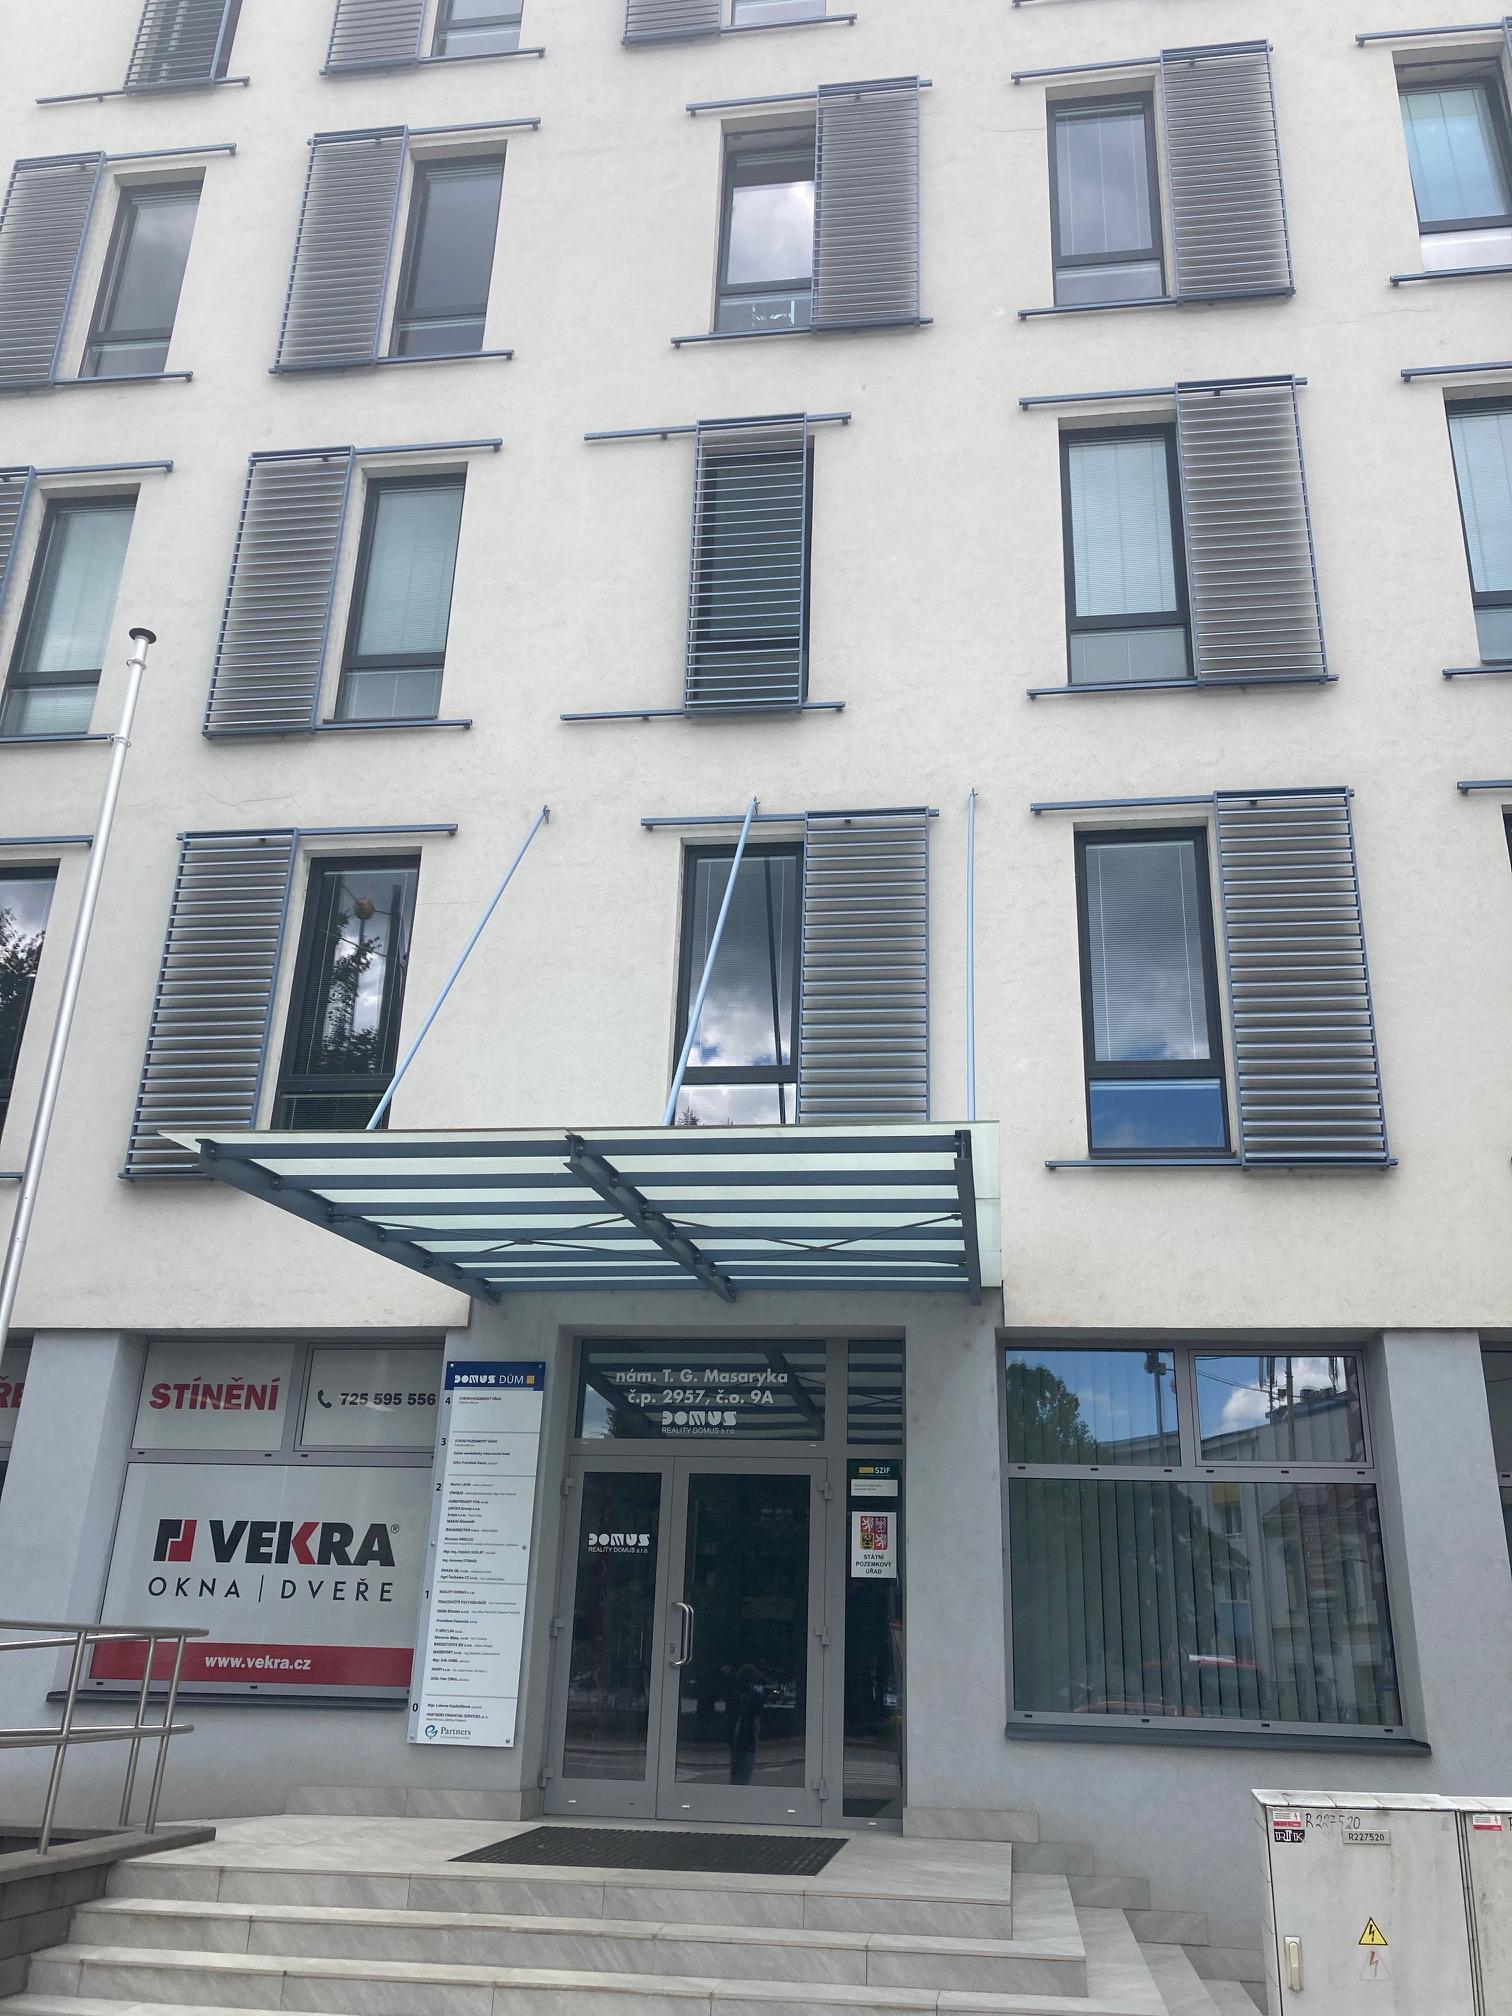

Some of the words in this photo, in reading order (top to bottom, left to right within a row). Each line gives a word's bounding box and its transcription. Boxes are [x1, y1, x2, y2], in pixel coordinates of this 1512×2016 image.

[454, 1374, 496, 1384] DOMUS
[499, 1373, 524, 1384] DŮM
[616, 1368, 657, 1382] nám.
[663, 1369, 674, 1383] T.
[680, 1369, 698, 1383] G.
[703, 1368, 788, 1386] Masaryka
[149, 1377, 280, 1411] STÍNĚNÍ
[340, 1392, 369, 1406] 725
[373, 1392, 402, 1406] 595
[407, 1392, 436, 1406] 556
[627, 1389, 656, 1407] č.p.
[662, 1390, 709, 1406] 2957,
[716, 1389, 745, 1404] č.o.
[750, 1390, 774, 1404] 9A
[444, 1397, 451, 1405] 4
[662, 1410, 737, 1426] DOMUS
[440, 1437, 447, 1446] 3
[874, 1466, 891, 1474] SZIF
[436, 1483, 442, 1491] 2
[209, 1519, 396, 1567] VEKRA
[588, 1533, 650, 1546] DOMUS
[148, 1576, 241, 1598] OKNA
[281, 1578, 393, 1602] DVEŘE
[425, 1590, 430, 1599] 1
[205, 1655, 311, 1671] www.vekra.cz
[412, 1703, 419, 1712] 0
[440, 1726, 471, 1736] Partners
[1348, 1833, 1385, 1841] R227520
